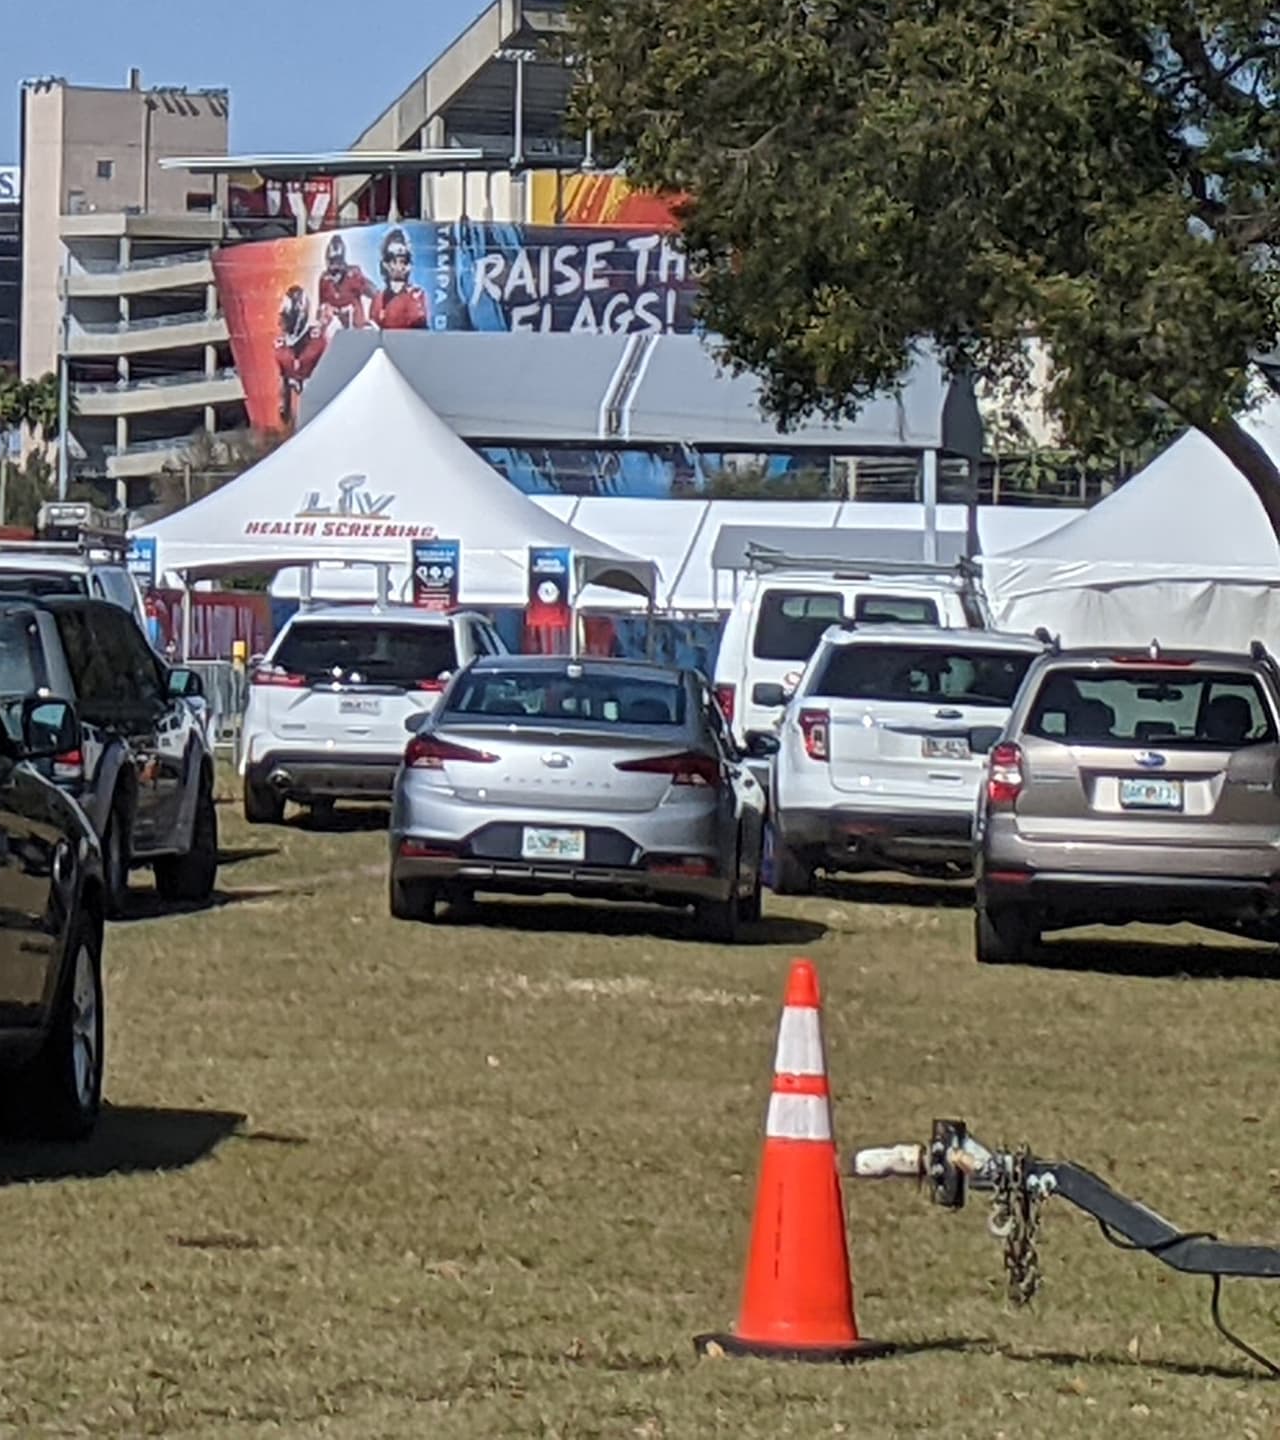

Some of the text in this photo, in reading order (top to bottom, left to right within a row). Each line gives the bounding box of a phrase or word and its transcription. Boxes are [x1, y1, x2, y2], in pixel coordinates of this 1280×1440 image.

[471, 234, 688, 306] RAISE TH
[508, 289, 677, 336] FLAGS!
[244, 520, 436, 539] HEALTH SCREENING
